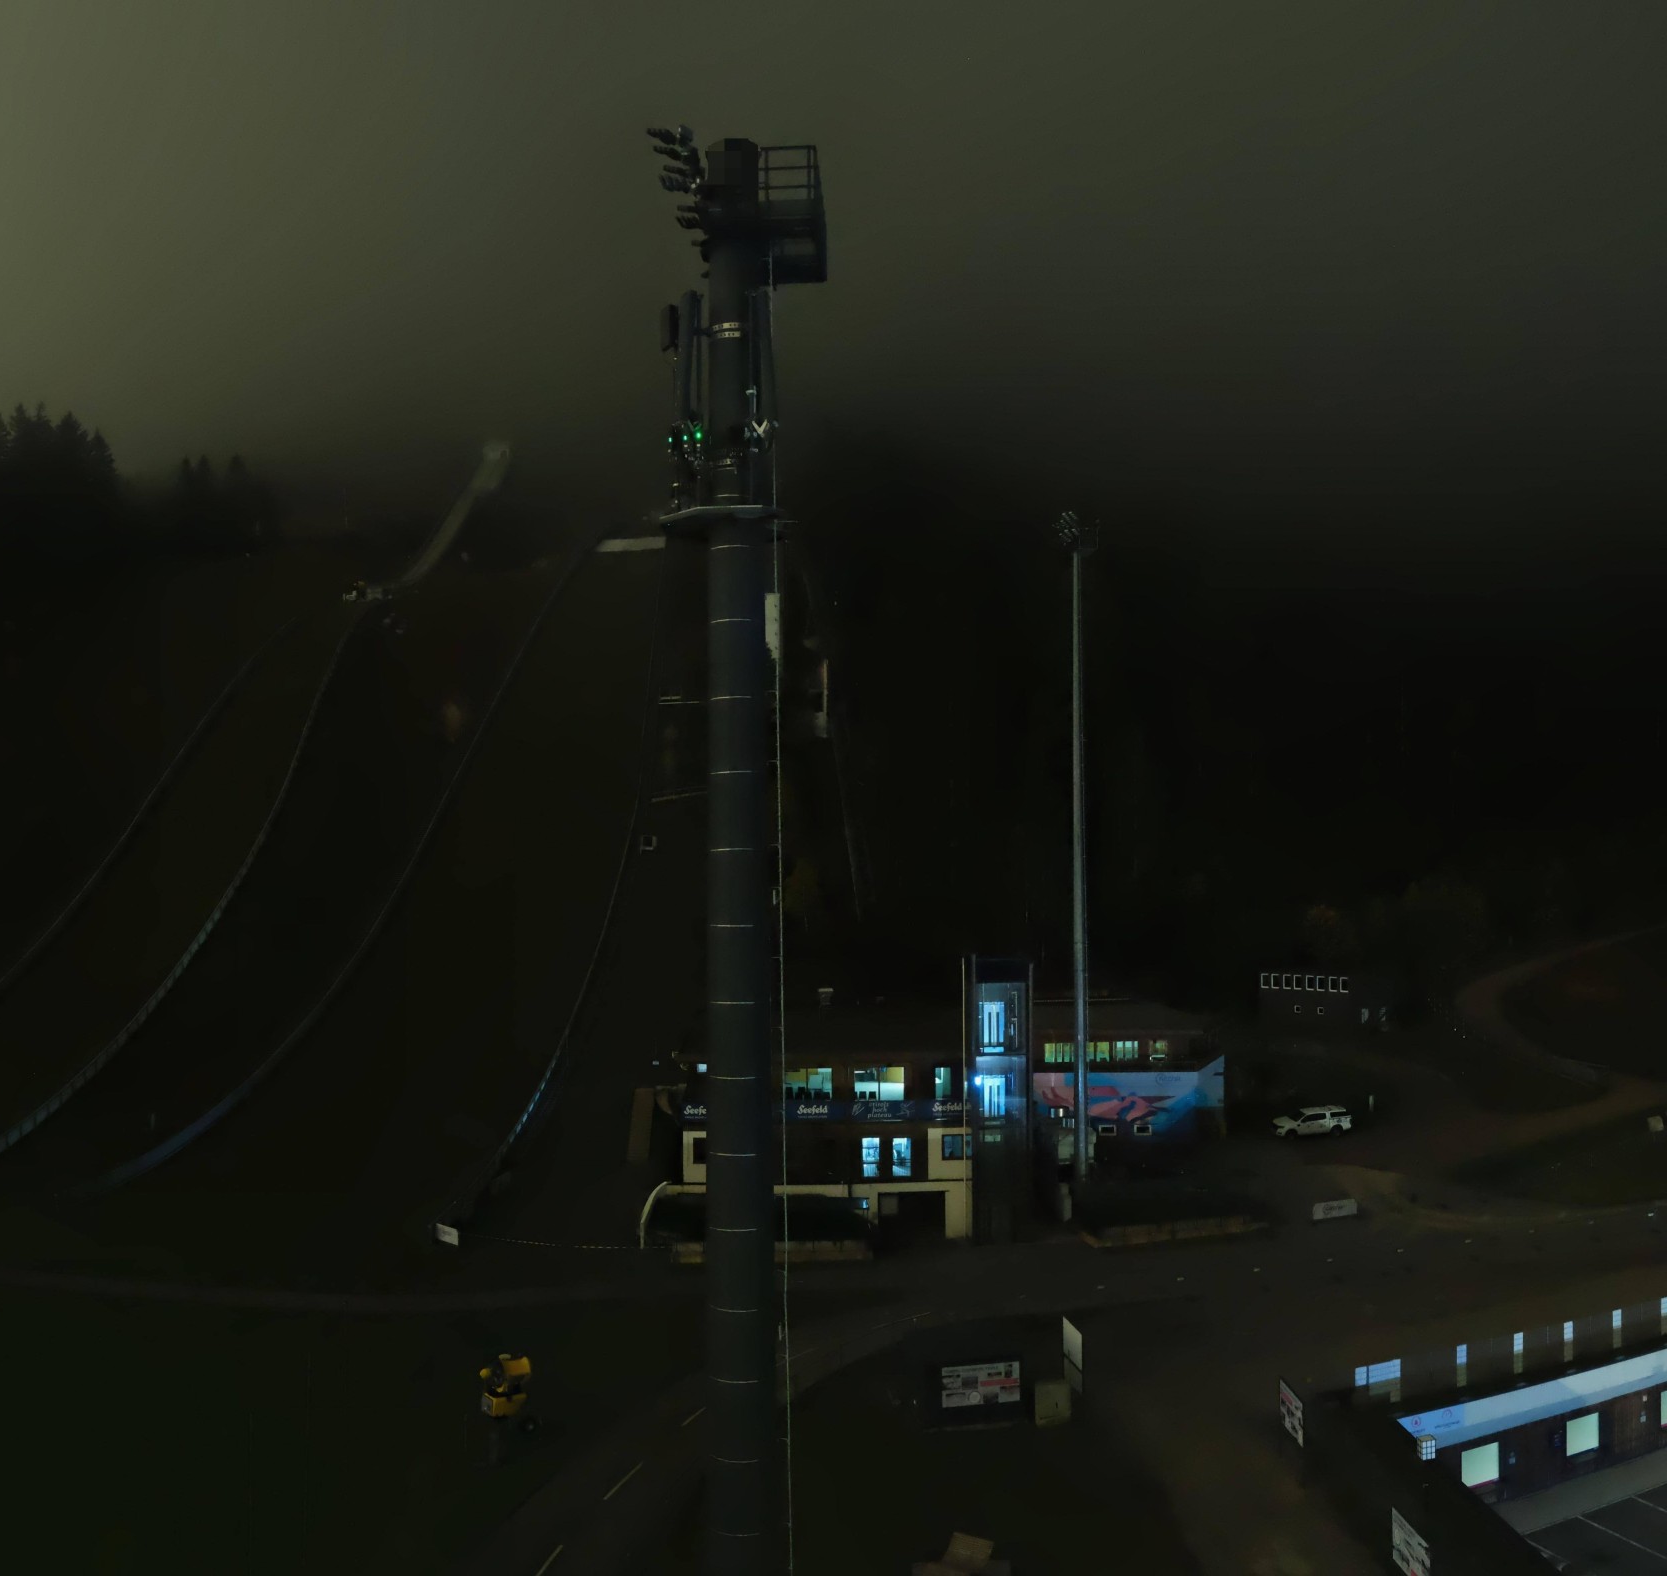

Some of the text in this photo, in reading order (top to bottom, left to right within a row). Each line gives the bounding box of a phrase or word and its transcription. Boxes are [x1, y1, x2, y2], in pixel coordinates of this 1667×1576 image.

[683, 1105, 708, 1116] Seefe
[796, 1104, 829, 1116] Seefeld
[931, 1102, 963, 1112] Seefeld
